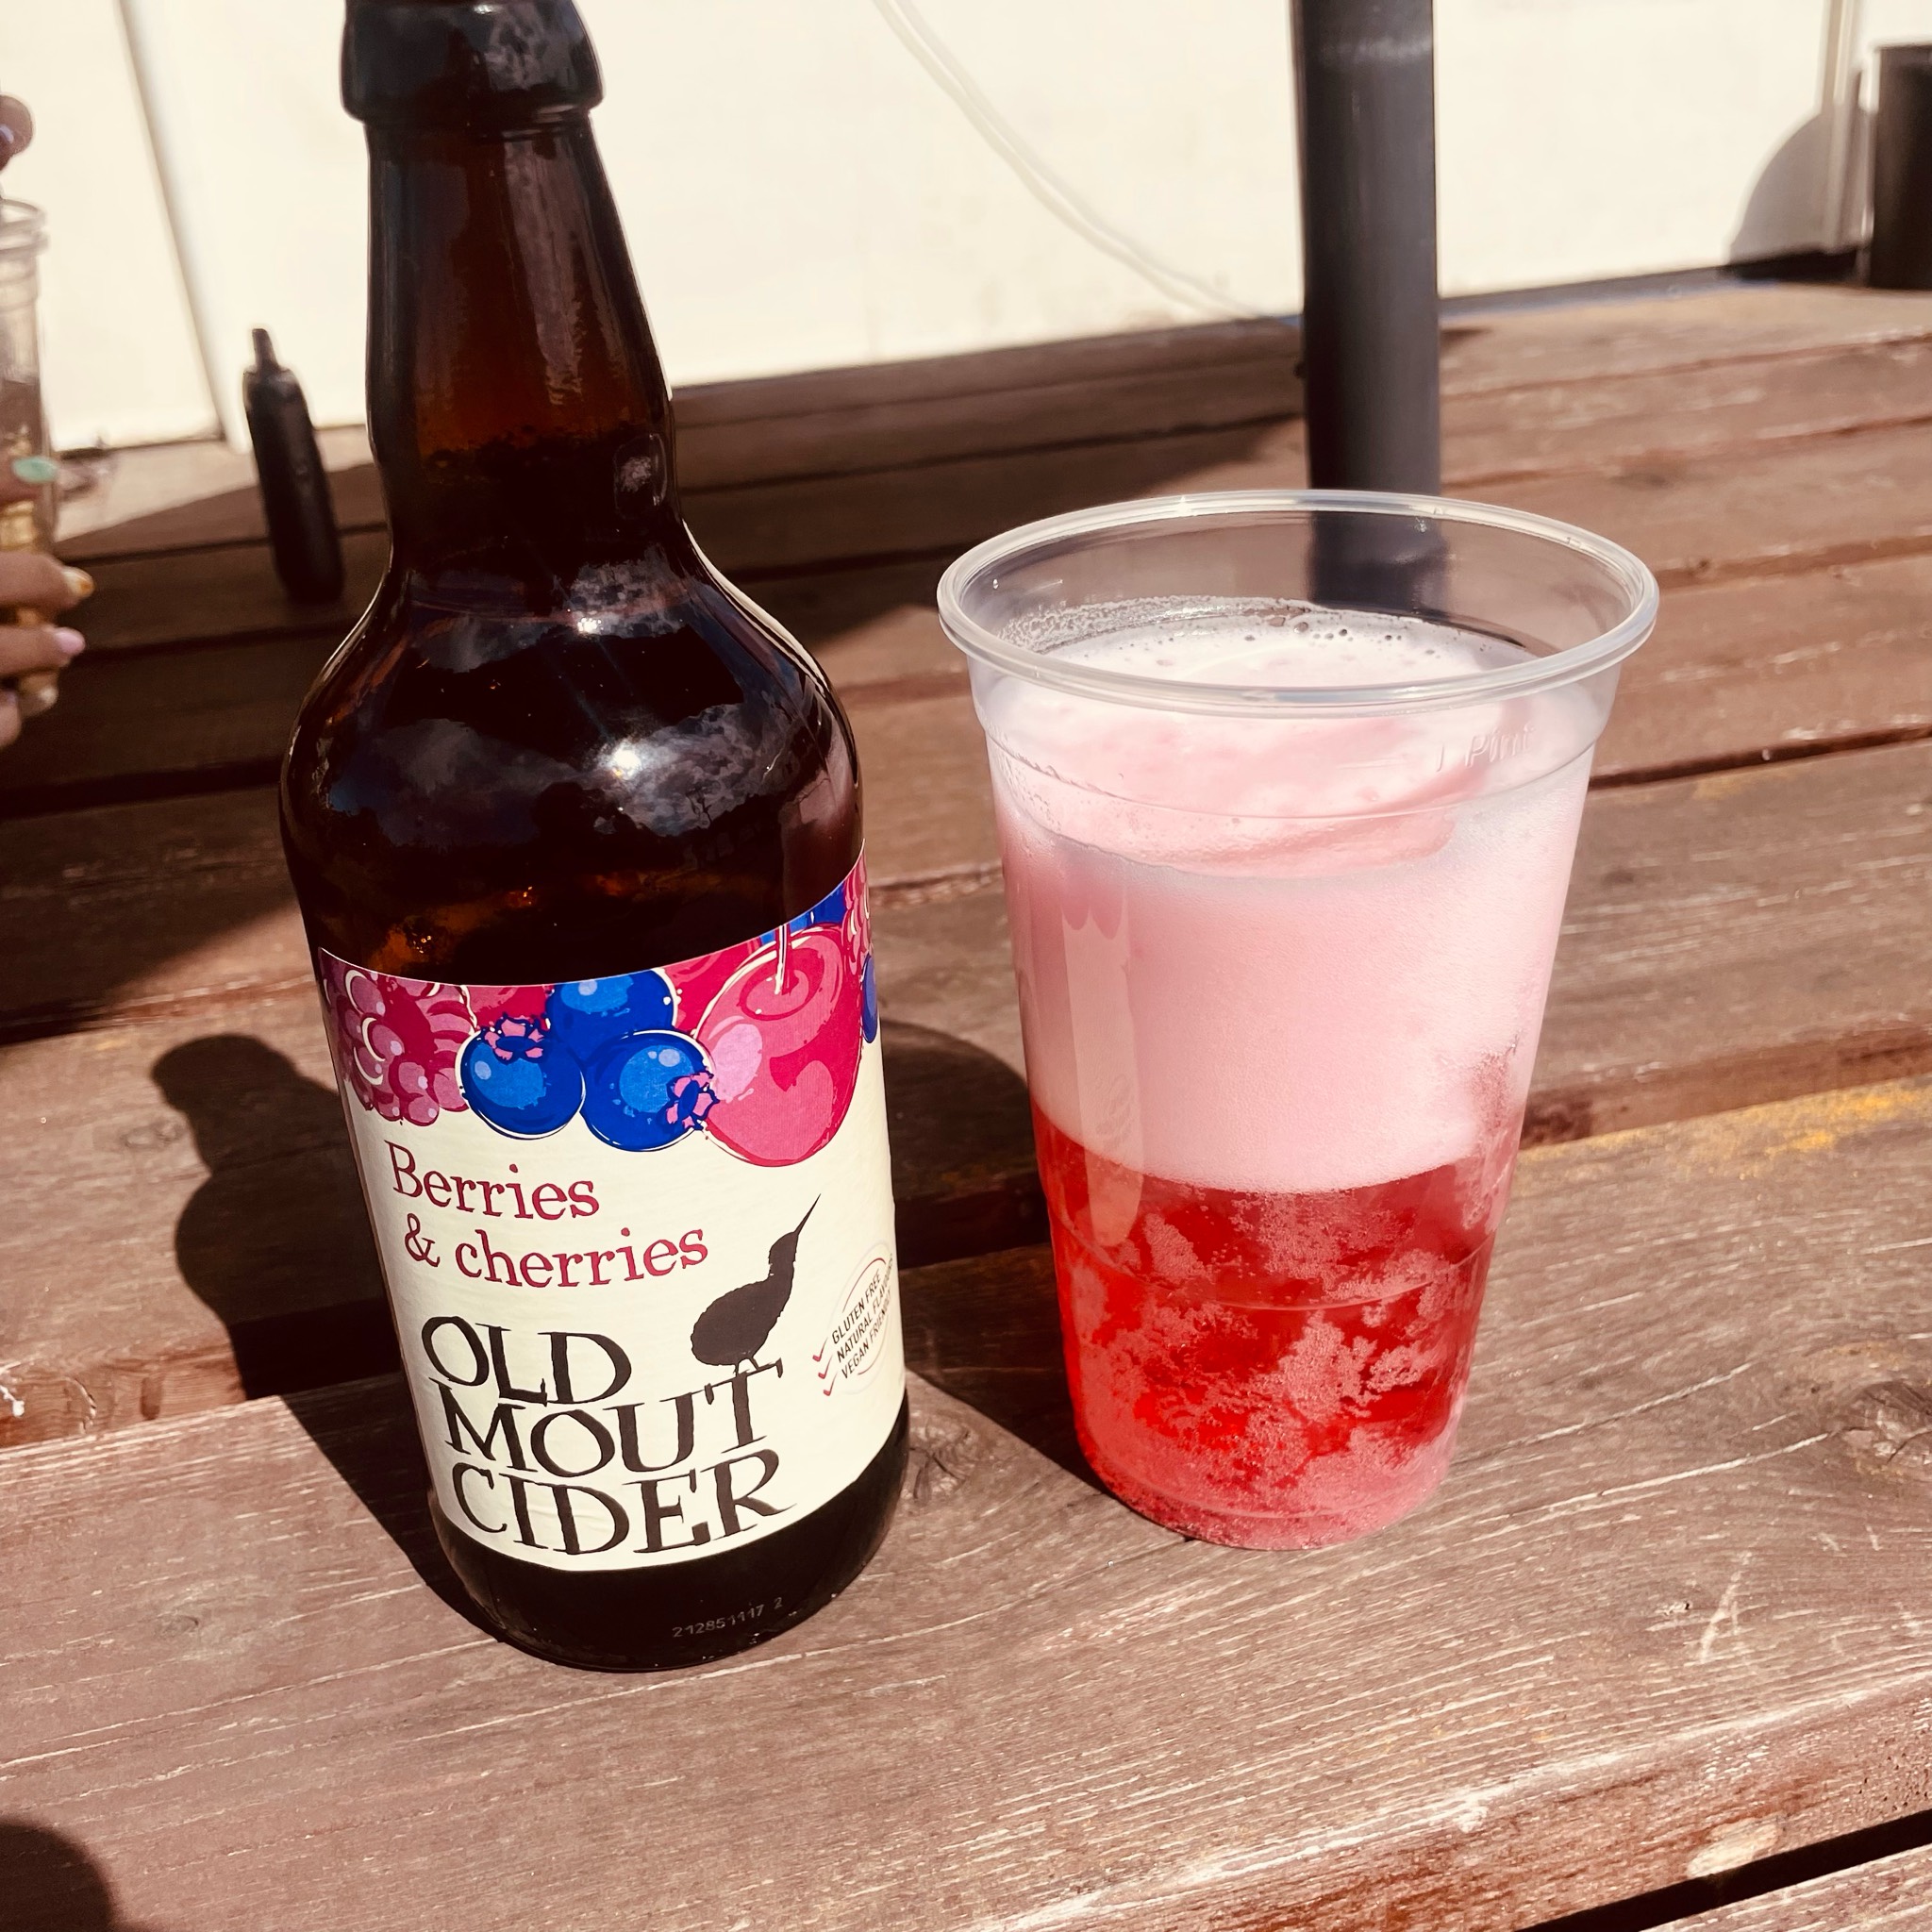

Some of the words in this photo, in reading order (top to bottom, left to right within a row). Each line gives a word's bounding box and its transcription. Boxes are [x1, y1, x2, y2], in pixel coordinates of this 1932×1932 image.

[385, 1141, 600, 1220] Berries
[405, 1213, 441, 1267] &
[455, 1227, 708, 1288] cherries
[832, 1297, 865, 1345] GLUTEN
[865, 1268, 881, 1304] FREE
[836, 1310, 874, 1363] NATURAL
[421, 1316, 632, 1405] OLD
[841, 1338, 870, 1379] VEGAN
[429, 1357, 784, 1477] MOUT
[452, 1449, 798, 1555] CIDER
[773, 1596, 783, 1609] 2
